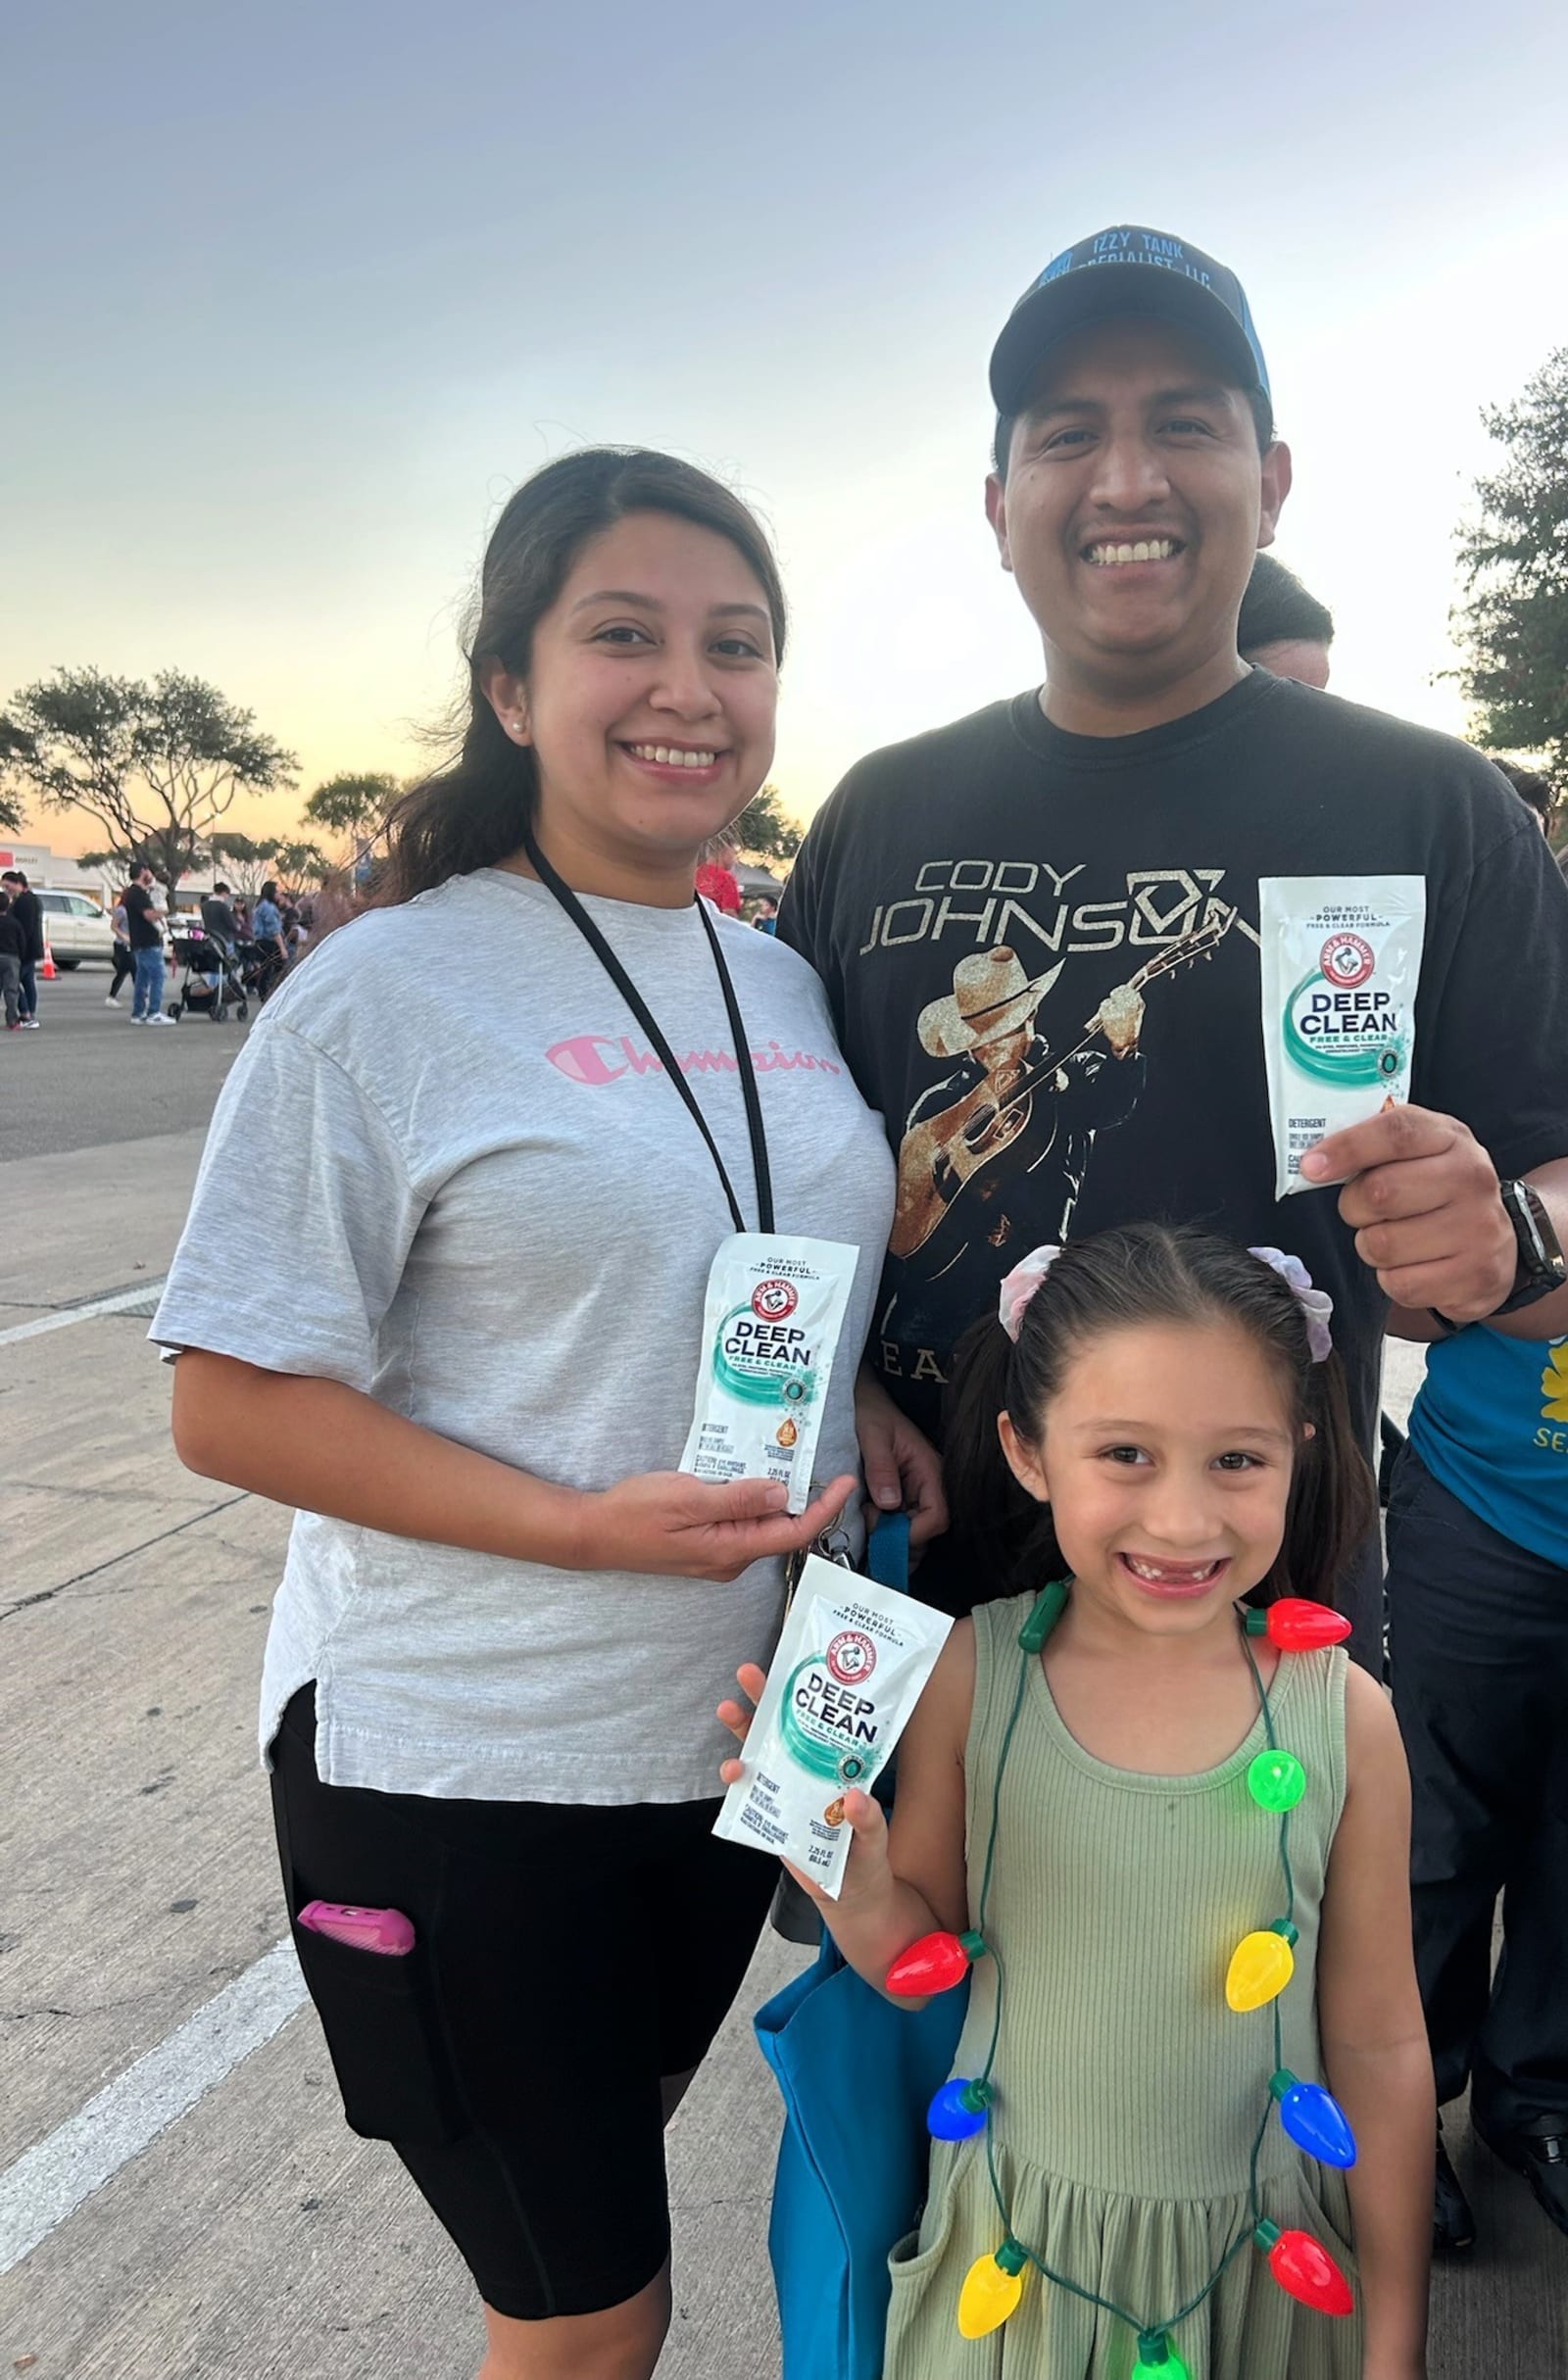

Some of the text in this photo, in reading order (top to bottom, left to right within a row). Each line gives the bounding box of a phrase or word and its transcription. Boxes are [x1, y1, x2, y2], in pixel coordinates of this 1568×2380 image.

[1093, 230, 1184, 260] IZZY TANK
[914, 859, 1087, 897] CODY
[1310, 992, 1391, 1013] DEEP
[1299, 1012, 1398, 1036] CLEAN
[1352, 1034, 1388, 1043] CLEAR
[545, 1034, 841, 1086] Chmpion
[760, 1261, 811, 1275] POWERFUL
[735, 1321, 806, 1344] DEEP
[725, 1336, 811, 1366] CLEAN
[1533, 1427, 1568, 1453] SE
[843, 1606, 896, 1636] POWERFUL
[807, 1672, 876, 1716] DEEP
[795, 1687, 879, 1744] CLEAN
